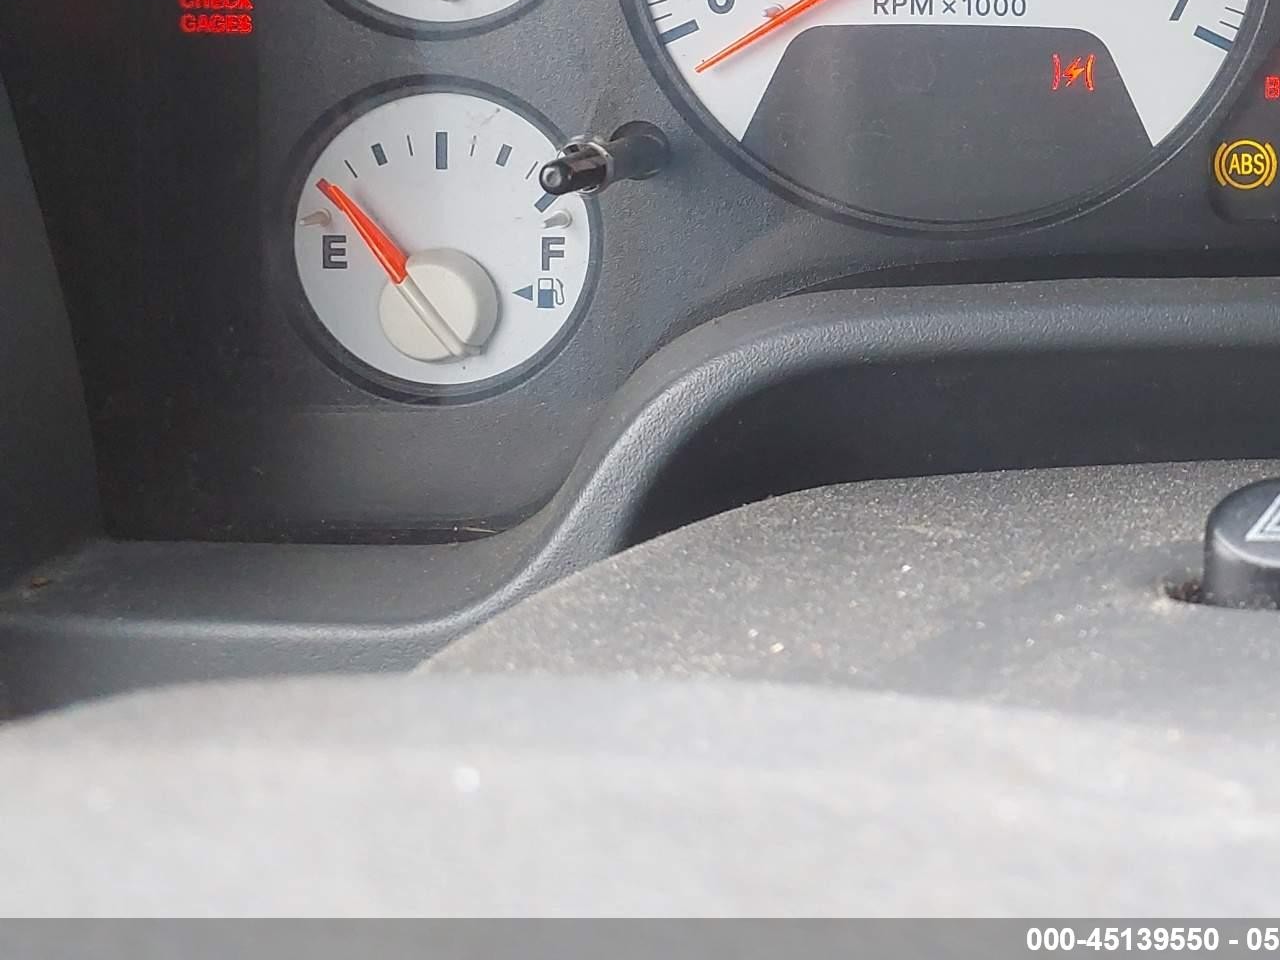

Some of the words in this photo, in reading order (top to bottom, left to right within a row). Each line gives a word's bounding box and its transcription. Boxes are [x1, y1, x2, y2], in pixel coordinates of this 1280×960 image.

[1228, 154, 1265, 174] ABS
[323, 235, 347, 269] E
[542, 237, 565, 270] F
